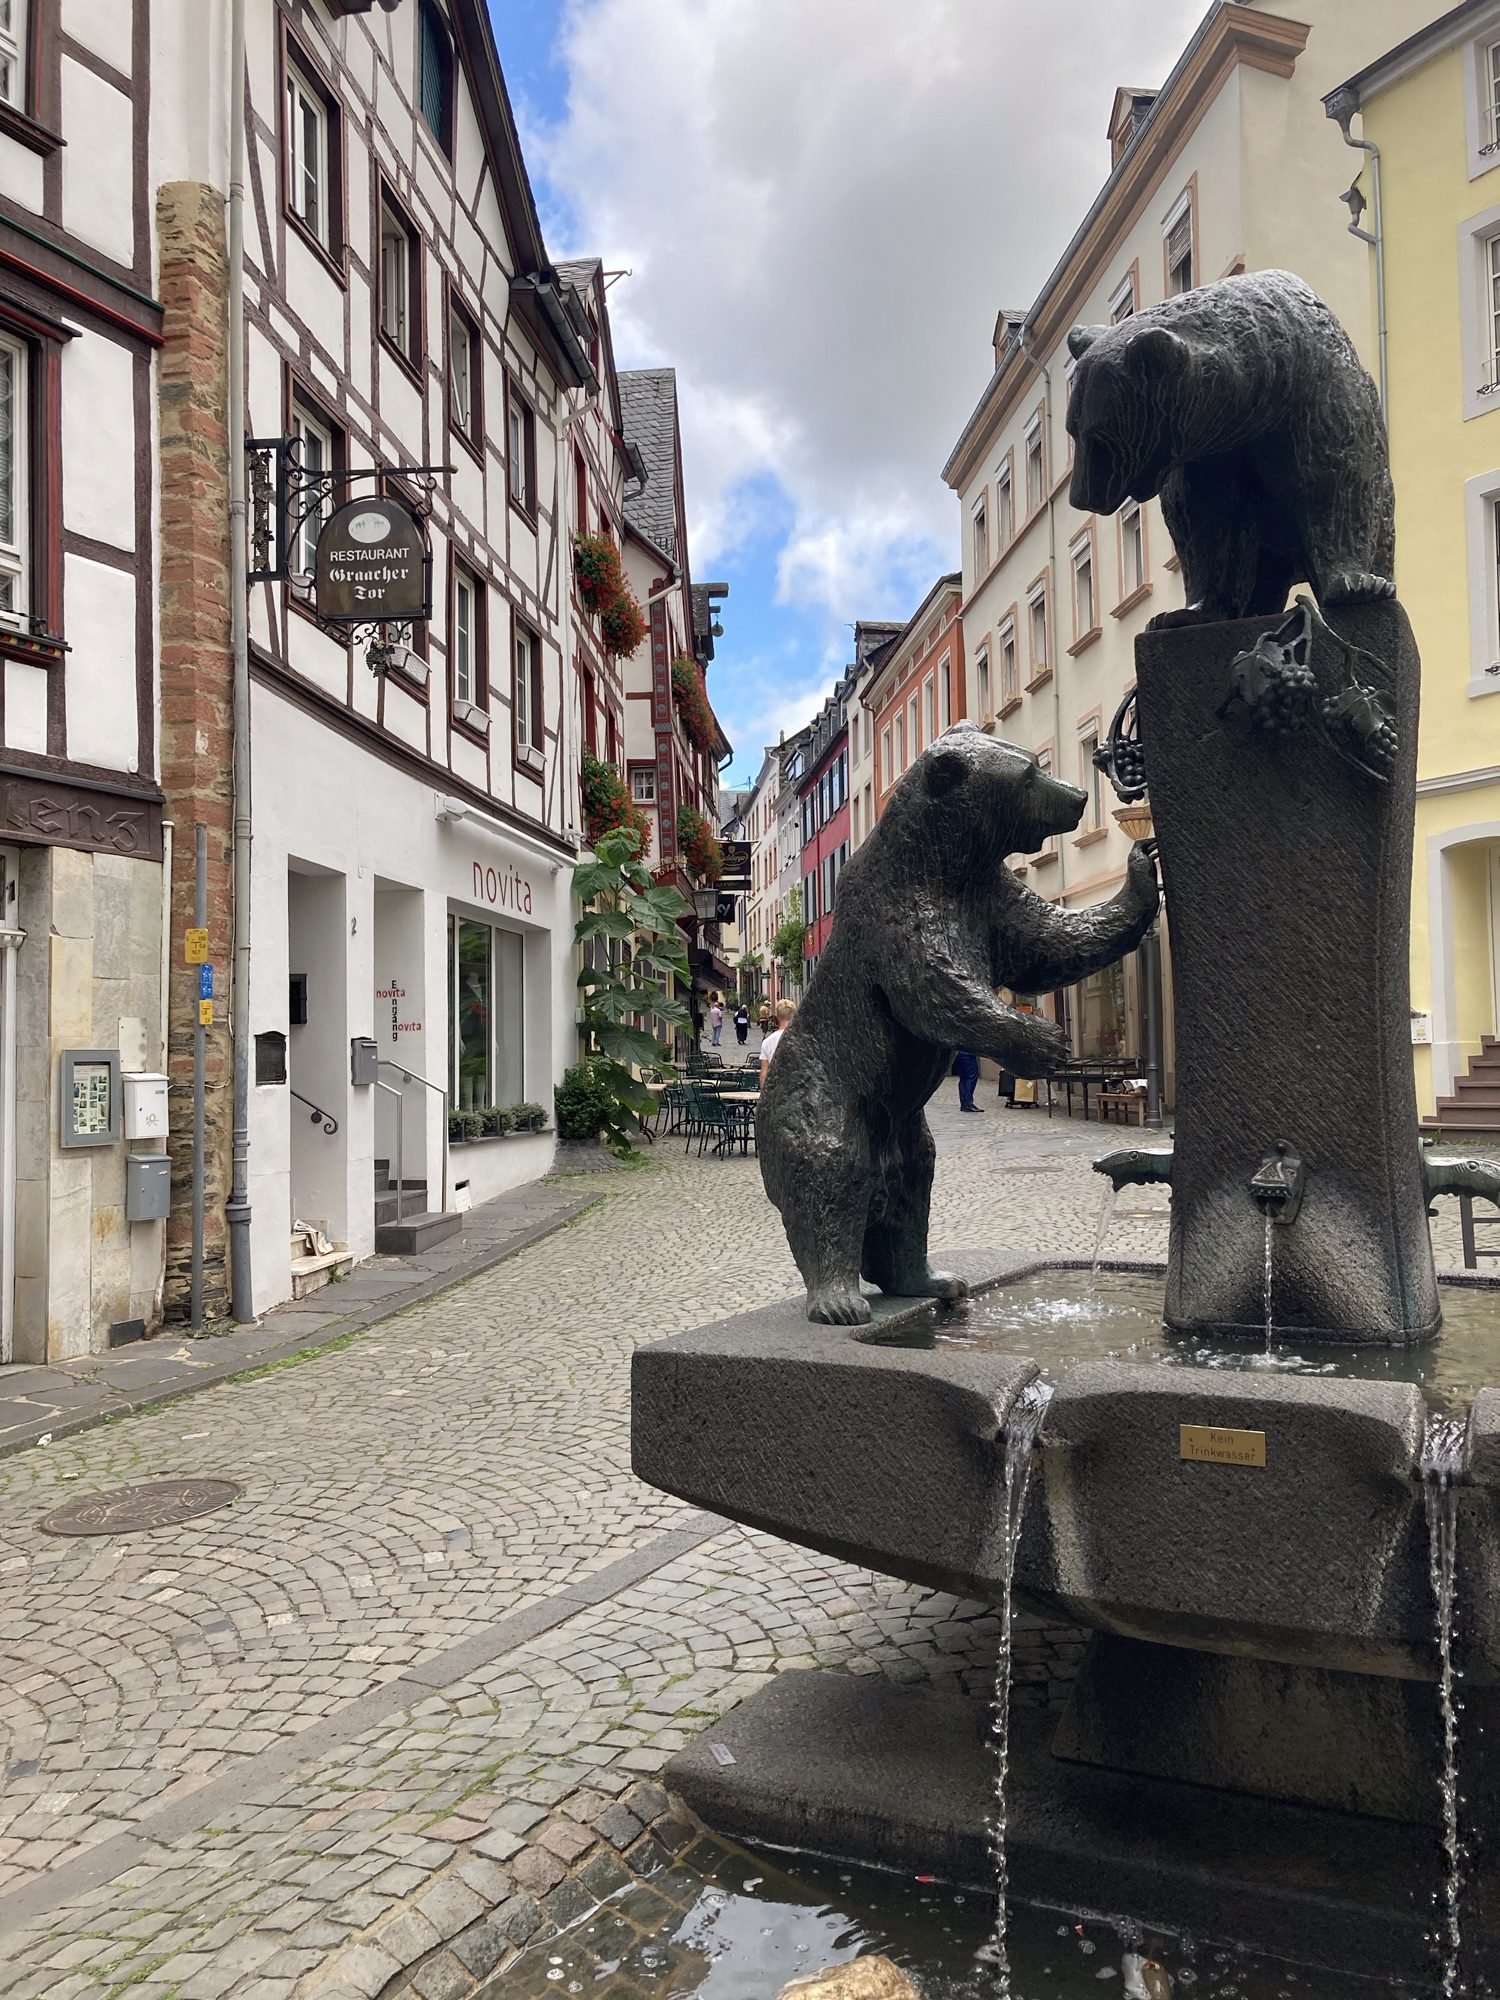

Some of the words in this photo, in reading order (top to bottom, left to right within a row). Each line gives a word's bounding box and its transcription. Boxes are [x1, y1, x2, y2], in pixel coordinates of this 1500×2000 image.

[330, 547, 410, 562] RESTAURANT
[329, 565, 409, 584] Graacher
[354, 585, 386, 600] Tor
[472, 861, 532, 915] novita
[376, 988, 405, 998] novita
[1210, 1432, 1234, 1444] Kein
[1189, 1444, 1256, 1461] Trinkwasser
